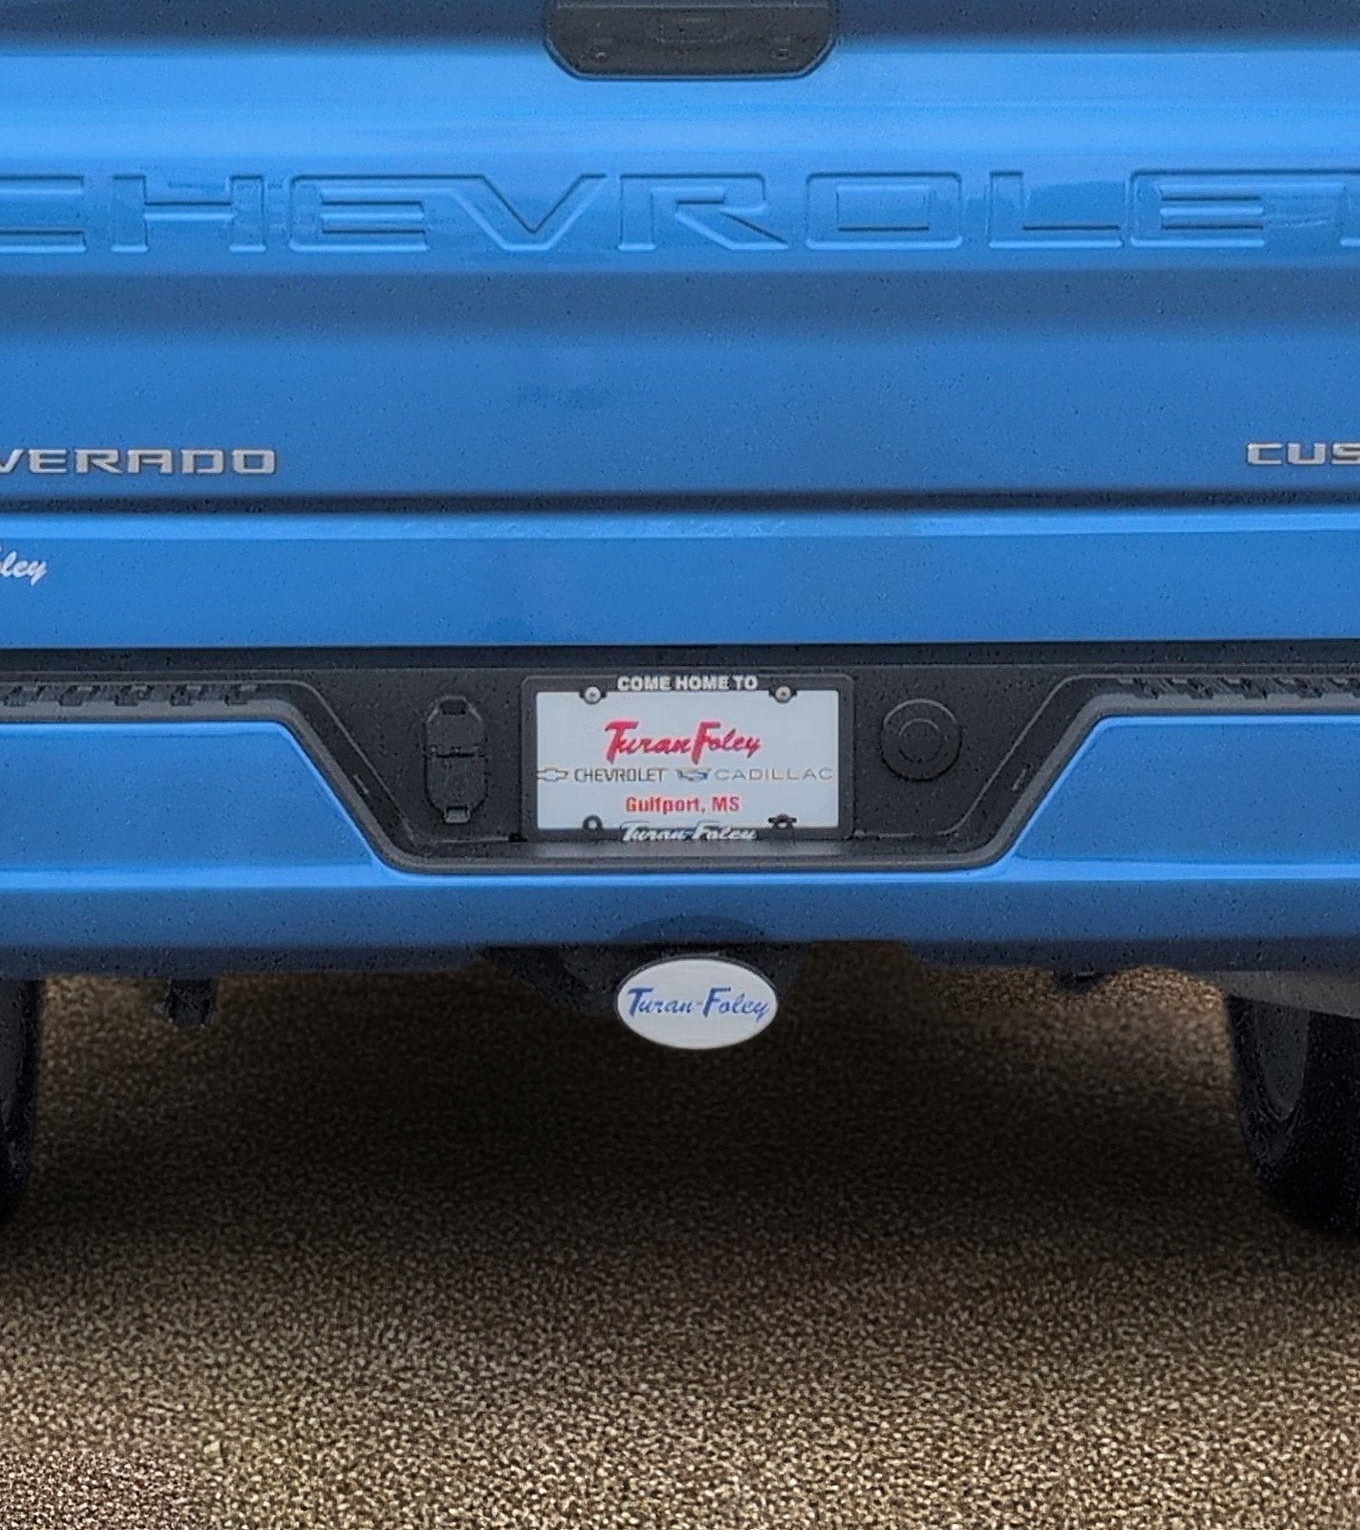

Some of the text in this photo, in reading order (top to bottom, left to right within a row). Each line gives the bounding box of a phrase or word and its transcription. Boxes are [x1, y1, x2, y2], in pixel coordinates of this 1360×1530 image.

[617, 675, 758, 692] COME HOME TO
[574, 767, 834, 783] CHEVROLET CADILLAC
[625, 796, 741, 815] Gulfport, MS
